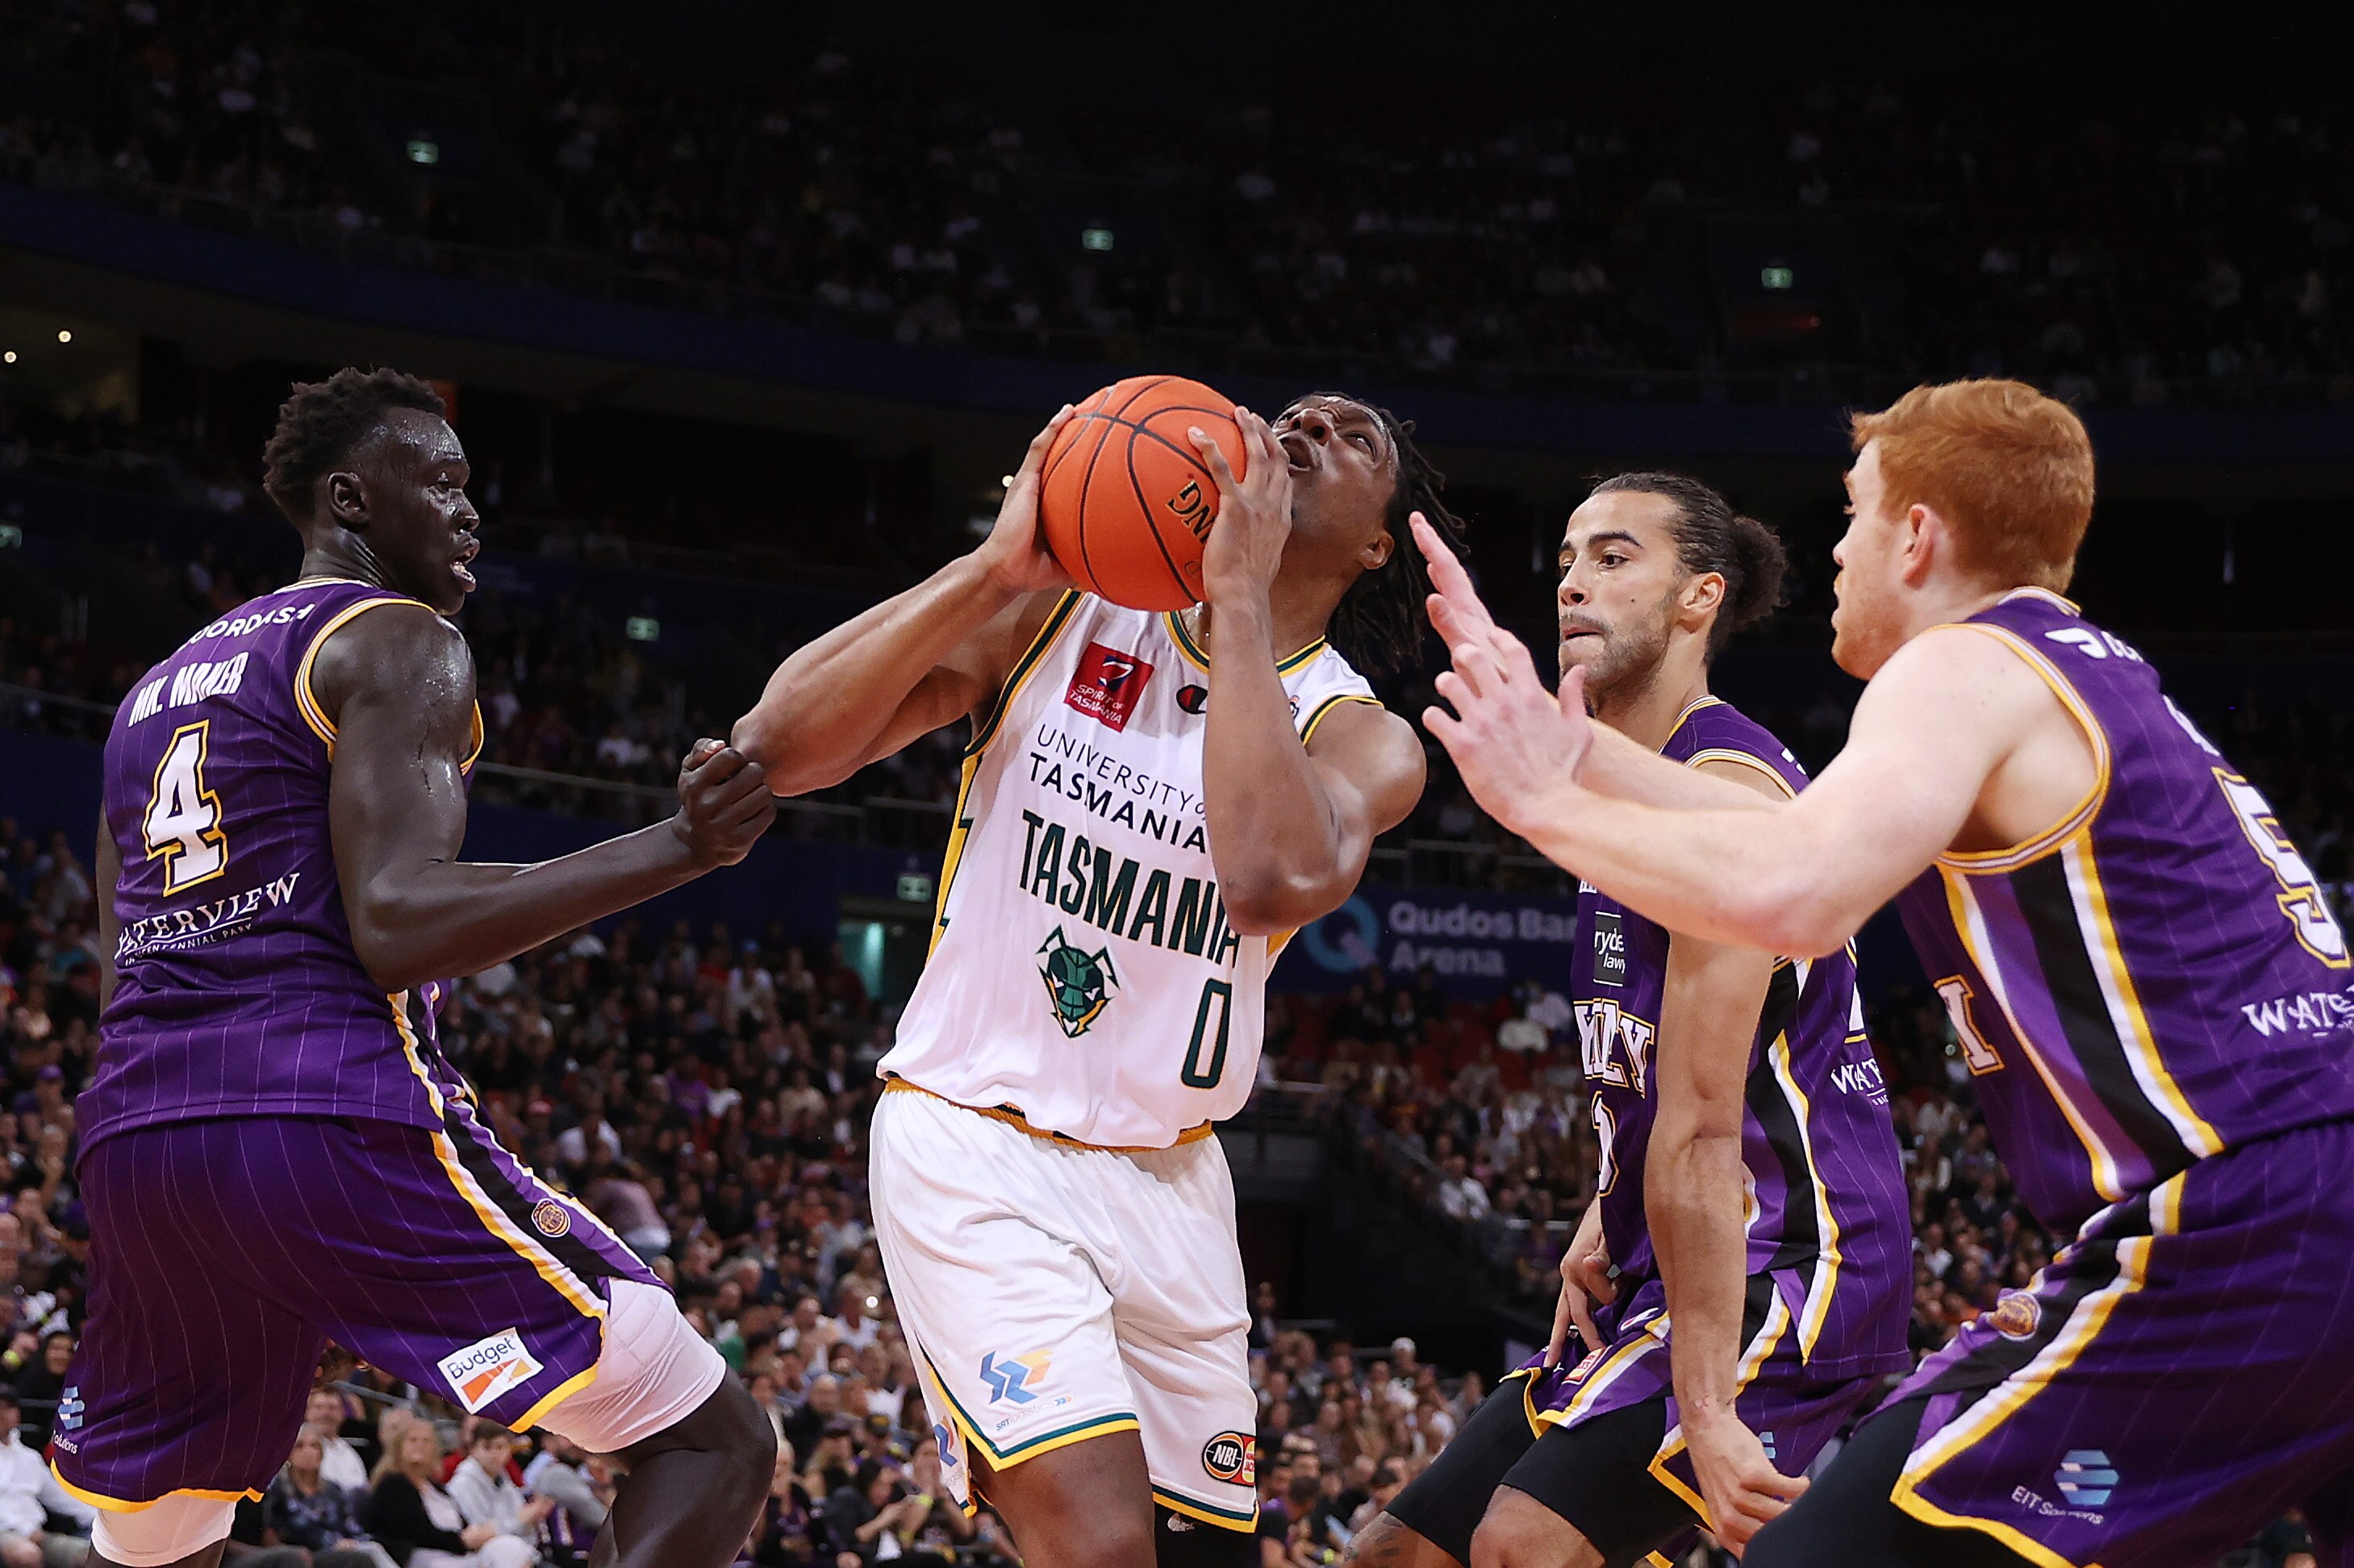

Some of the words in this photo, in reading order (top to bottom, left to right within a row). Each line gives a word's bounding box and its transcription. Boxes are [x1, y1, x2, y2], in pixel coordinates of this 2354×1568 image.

[169, 652, 249, 708] MAKER
[1078, 684, 1113, 705] SPIRIT
[1112, 702, 1125, 711] OF
[1070, 690, 1123, 724] TASMANIA
[1037, 724, 1194, 812] UNIVERSITY
[142, 719, 229, 897] 4
[1030, 752, 1206, 854] TASMANIA
[1388, 900, 1513, 938] Qudos
[1388, 939, 1507, 978] Arena
[1594, 928, 1625, 955] ryde
[1181, 977, 1233, 1090] 0
[447, 1337, 516, 1379] Budget
[1212, 1444, 1238, 1468] NBL
[2011, 1485, 2043, 1508] EIT
